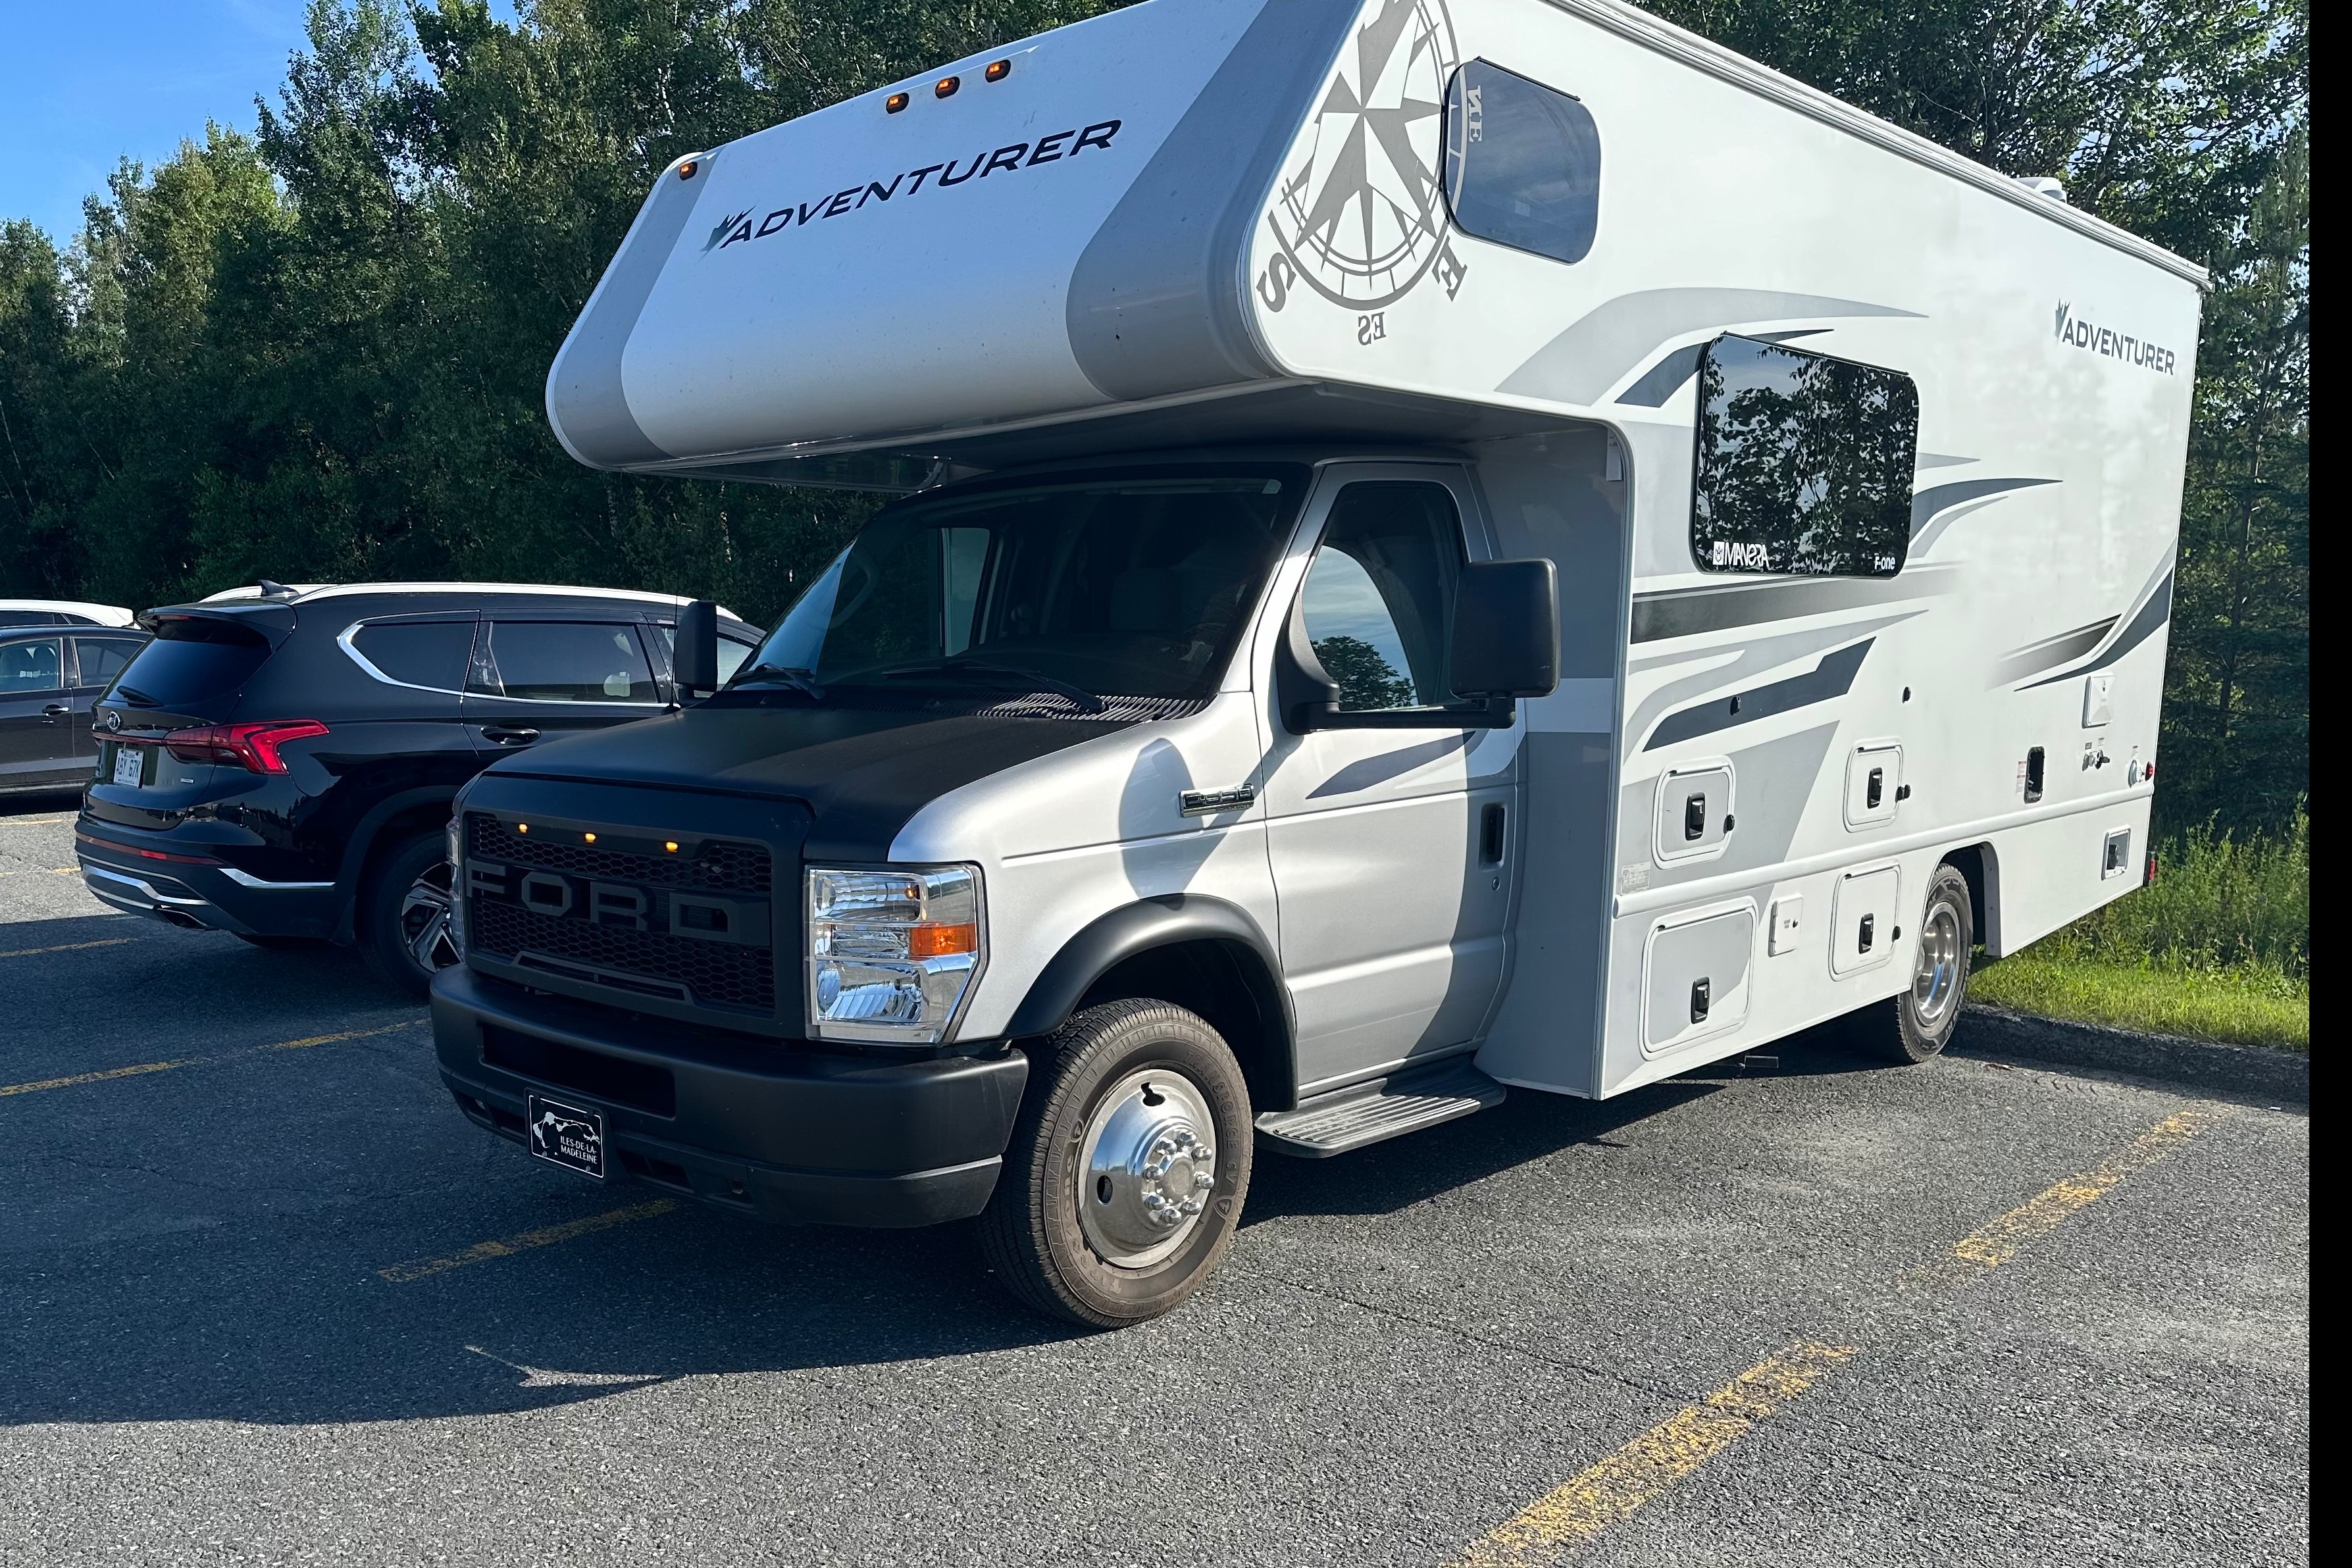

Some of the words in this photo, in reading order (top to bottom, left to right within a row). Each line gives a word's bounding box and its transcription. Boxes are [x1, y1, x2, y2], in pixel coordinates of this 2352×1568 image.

[719, 120, 1122, 249] ADVENTURER
[2062, 317, 2175, 376] ADVENTURER
[465, 857, 739, 942] FORD
[561, 1144, 598, 1164] MADELEINE
